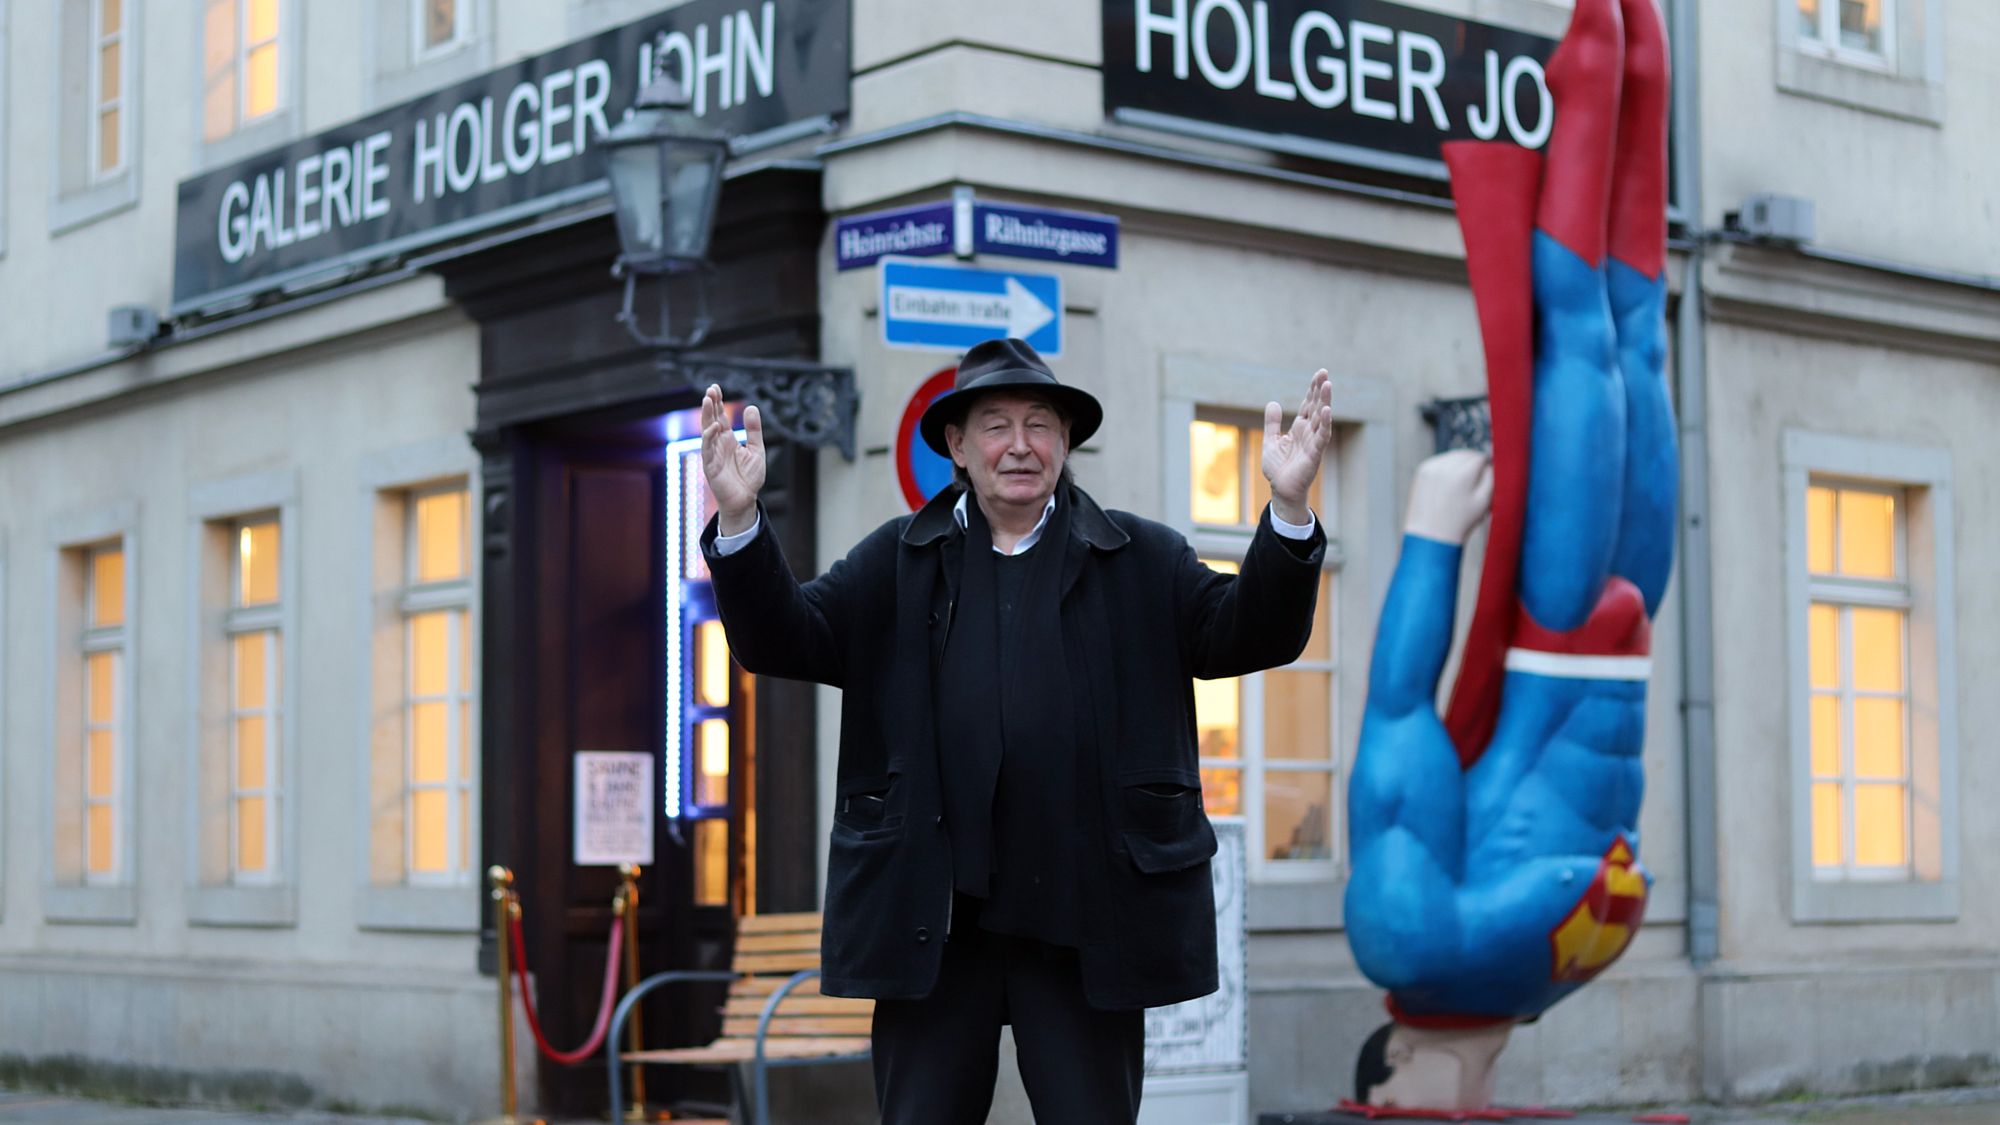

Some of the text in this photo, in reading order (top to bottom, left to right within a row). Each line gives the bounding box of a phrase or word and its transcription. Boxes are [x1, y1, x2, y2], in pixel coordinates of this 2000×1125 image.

[1135, 0, 1554, 150] HOLGER JO
[218, 131, 392, 264] GALERIE
[413, 58, 611, 204] HOLGER
[840, 220, 950, 260] Heinrichstr.
[985, 213, 1108, 256] Rähnitzgasse
